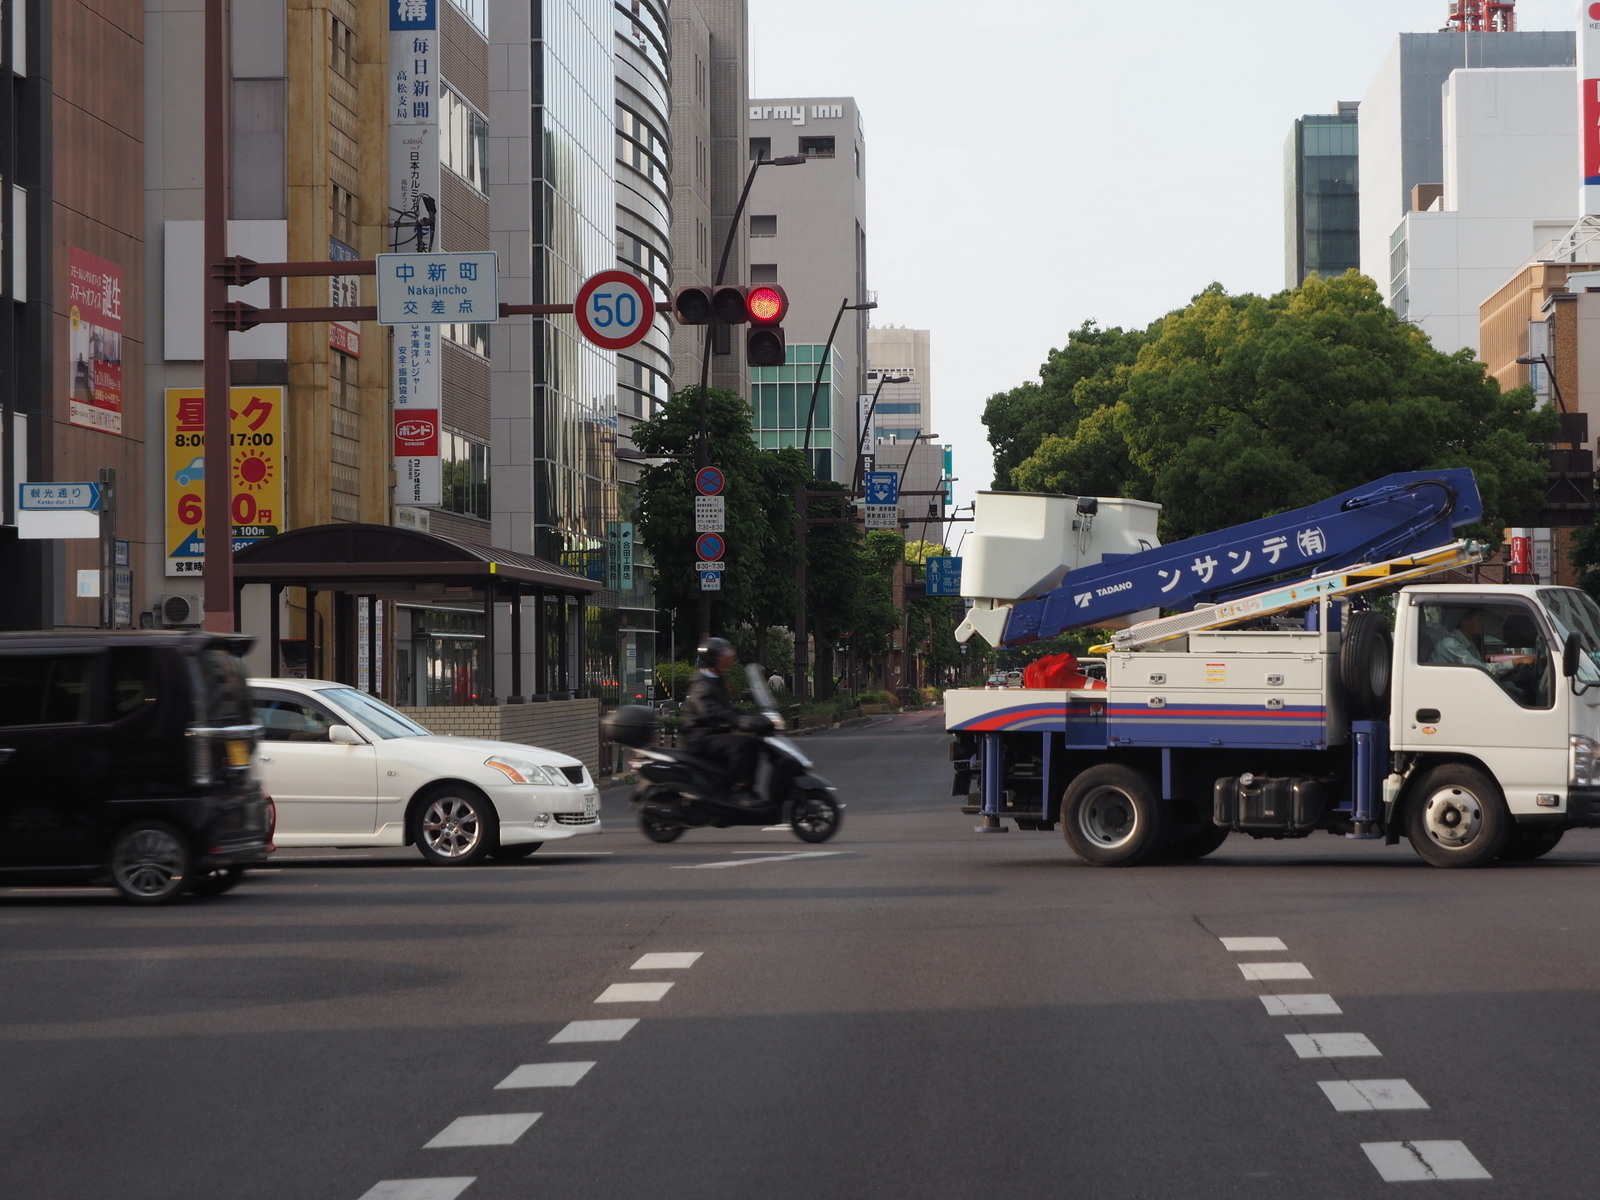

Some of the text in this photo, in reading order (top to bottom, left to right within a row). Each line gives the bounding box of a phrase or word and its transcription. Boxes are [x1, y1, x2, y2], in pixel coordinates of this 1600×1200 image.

[412, 37, 430, 119] 毎日新聞
[397, 71, 408, 119] 高松支局
[811, 104, 843, 119] inn
[396, 263, 479, 283] 中新町
[103, 273, 121, 320] 誕生
[407, 285, 468, 297] Nakajincho
[403, 299, 473, 315] 交差点
[592, 296, 637, 327] 50
[399, 425, 431, 436] ボンド
[30, 488, 81, 499] 観光通り
[240, 526, 265, 536] 100円
[1096, 581, 1133, 598] TADANO
